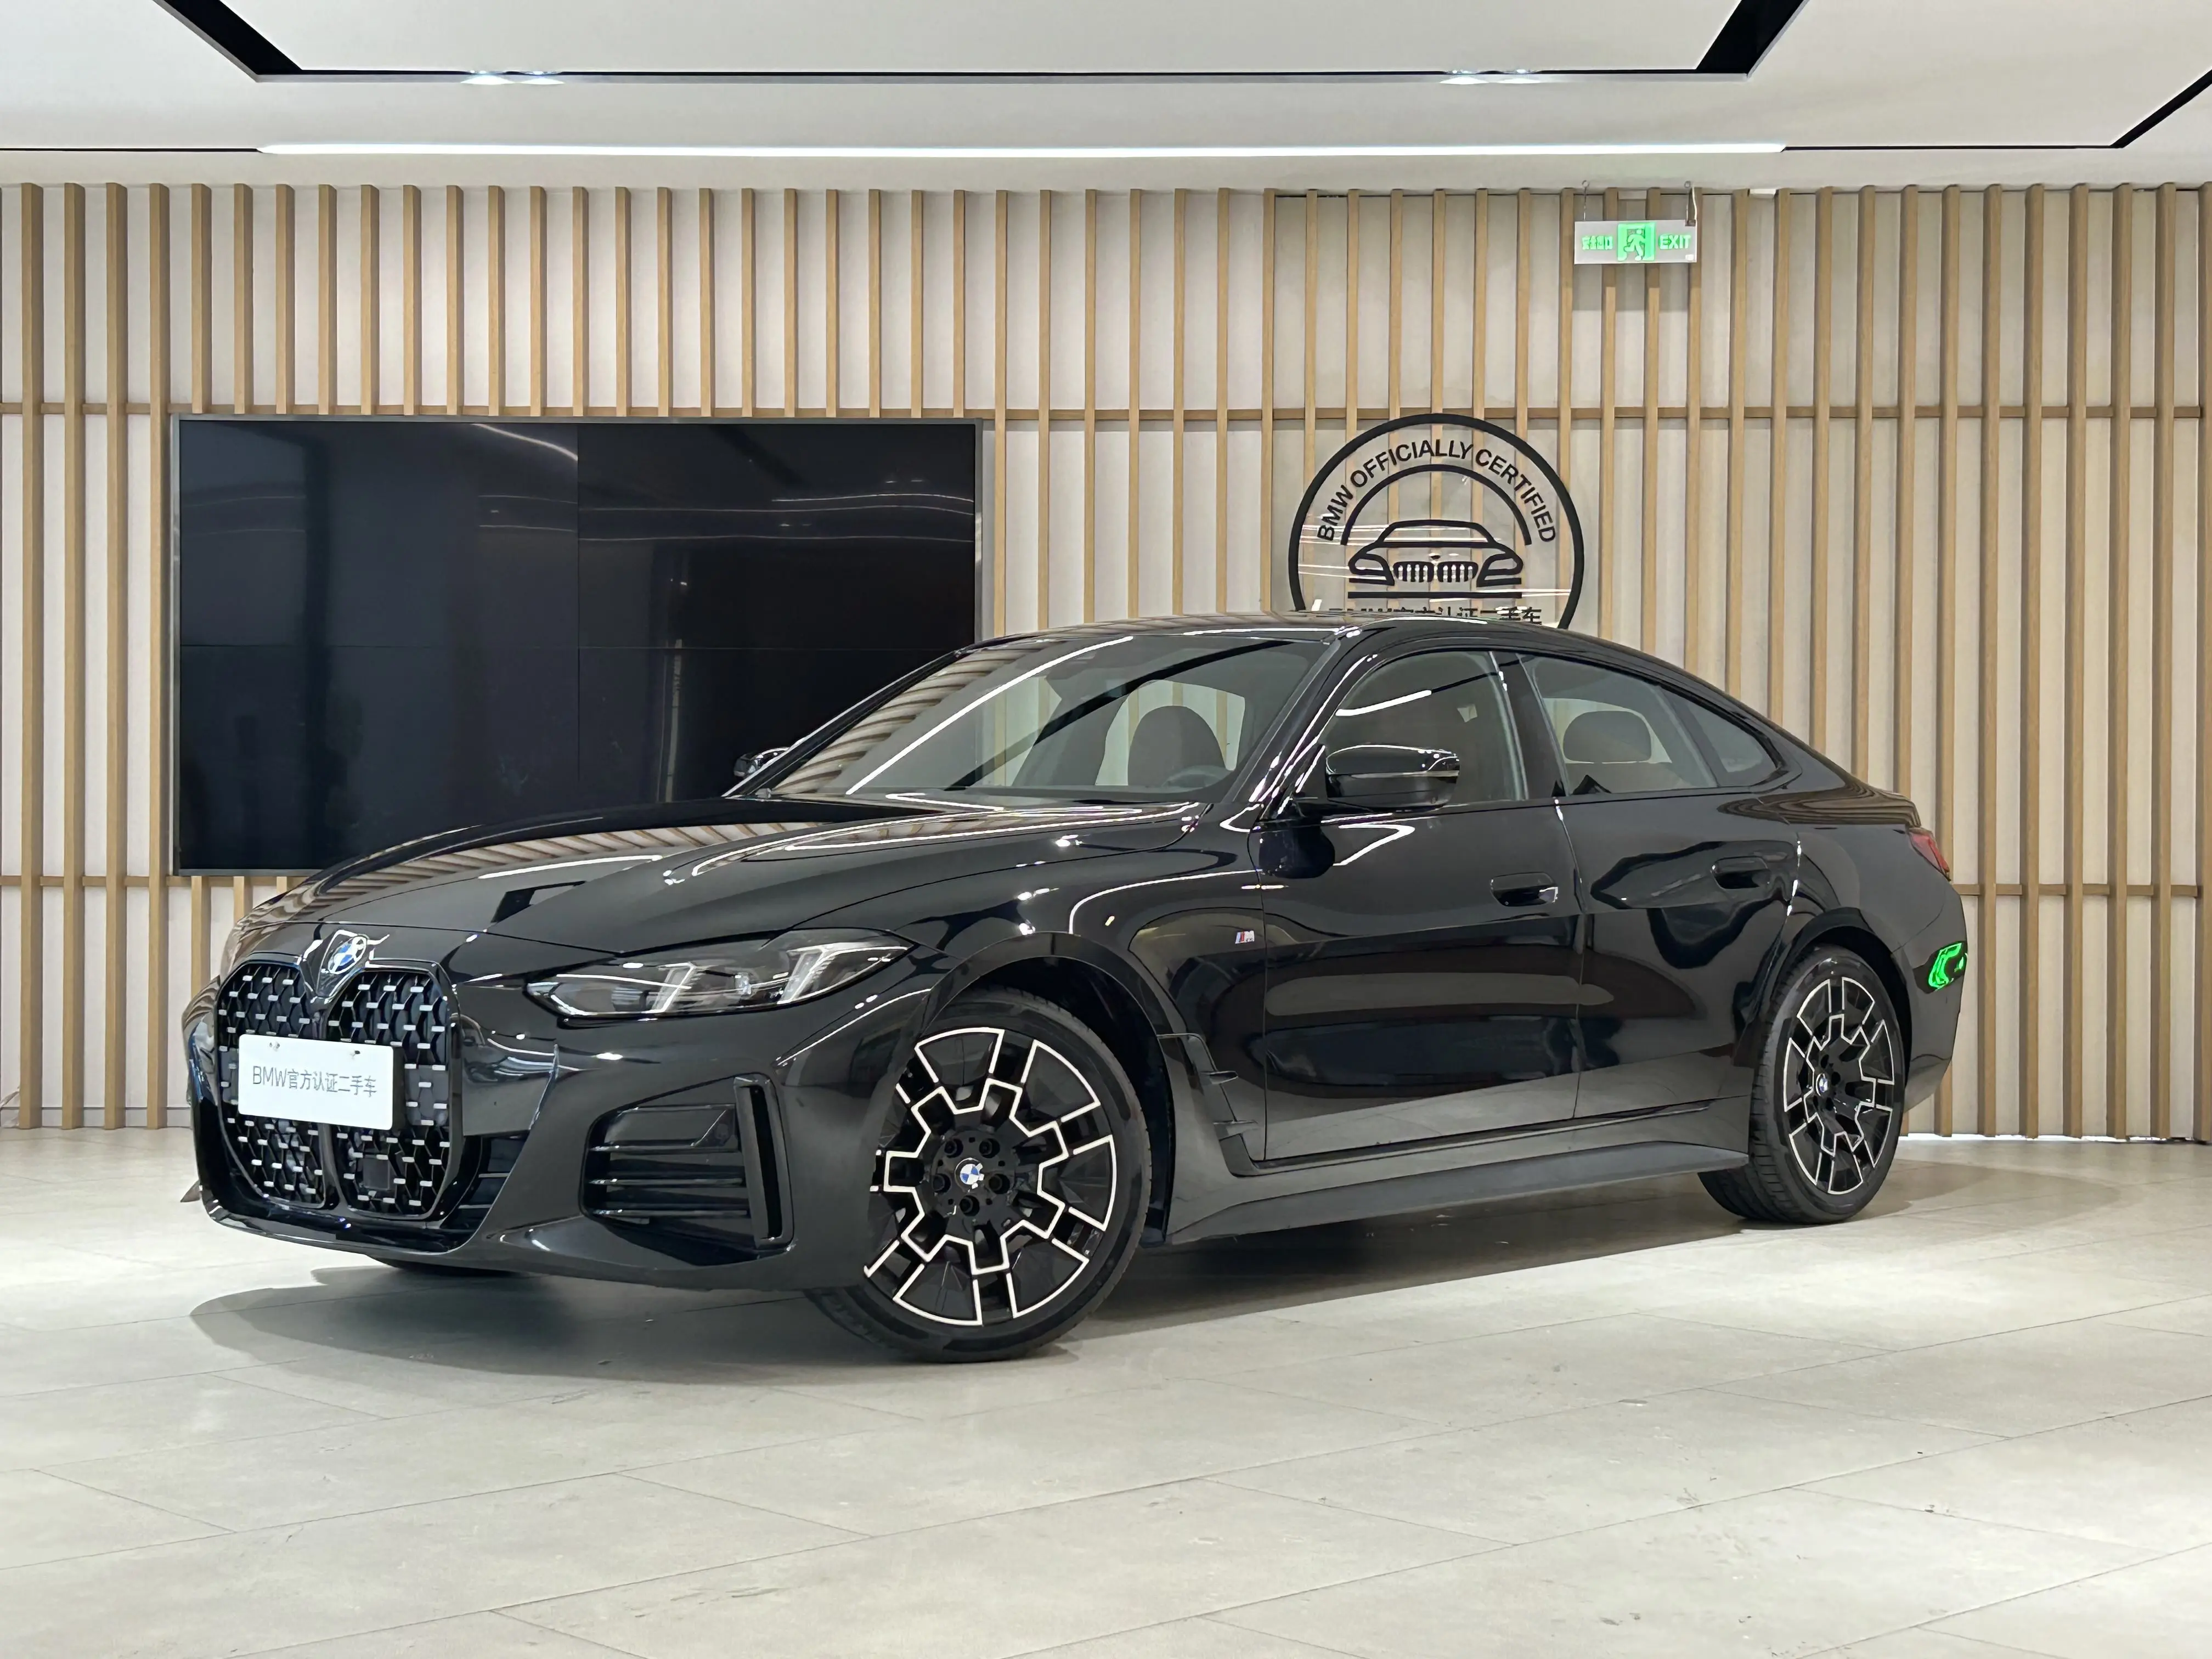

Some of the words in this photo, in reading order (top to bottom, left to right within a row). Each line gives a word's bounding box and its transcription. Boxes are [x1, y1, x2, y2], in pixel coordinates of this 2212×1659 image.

[1659, 235, 1690, 249] EXIT
[1317, 485, 1353, 541] BMW
[1350, 439, 1475, 488] OFFICIALLY
[1475, 448, 1556, 543] CERTIFIED
[253, 1066, 377, 1097] BMW官方认证二手车
